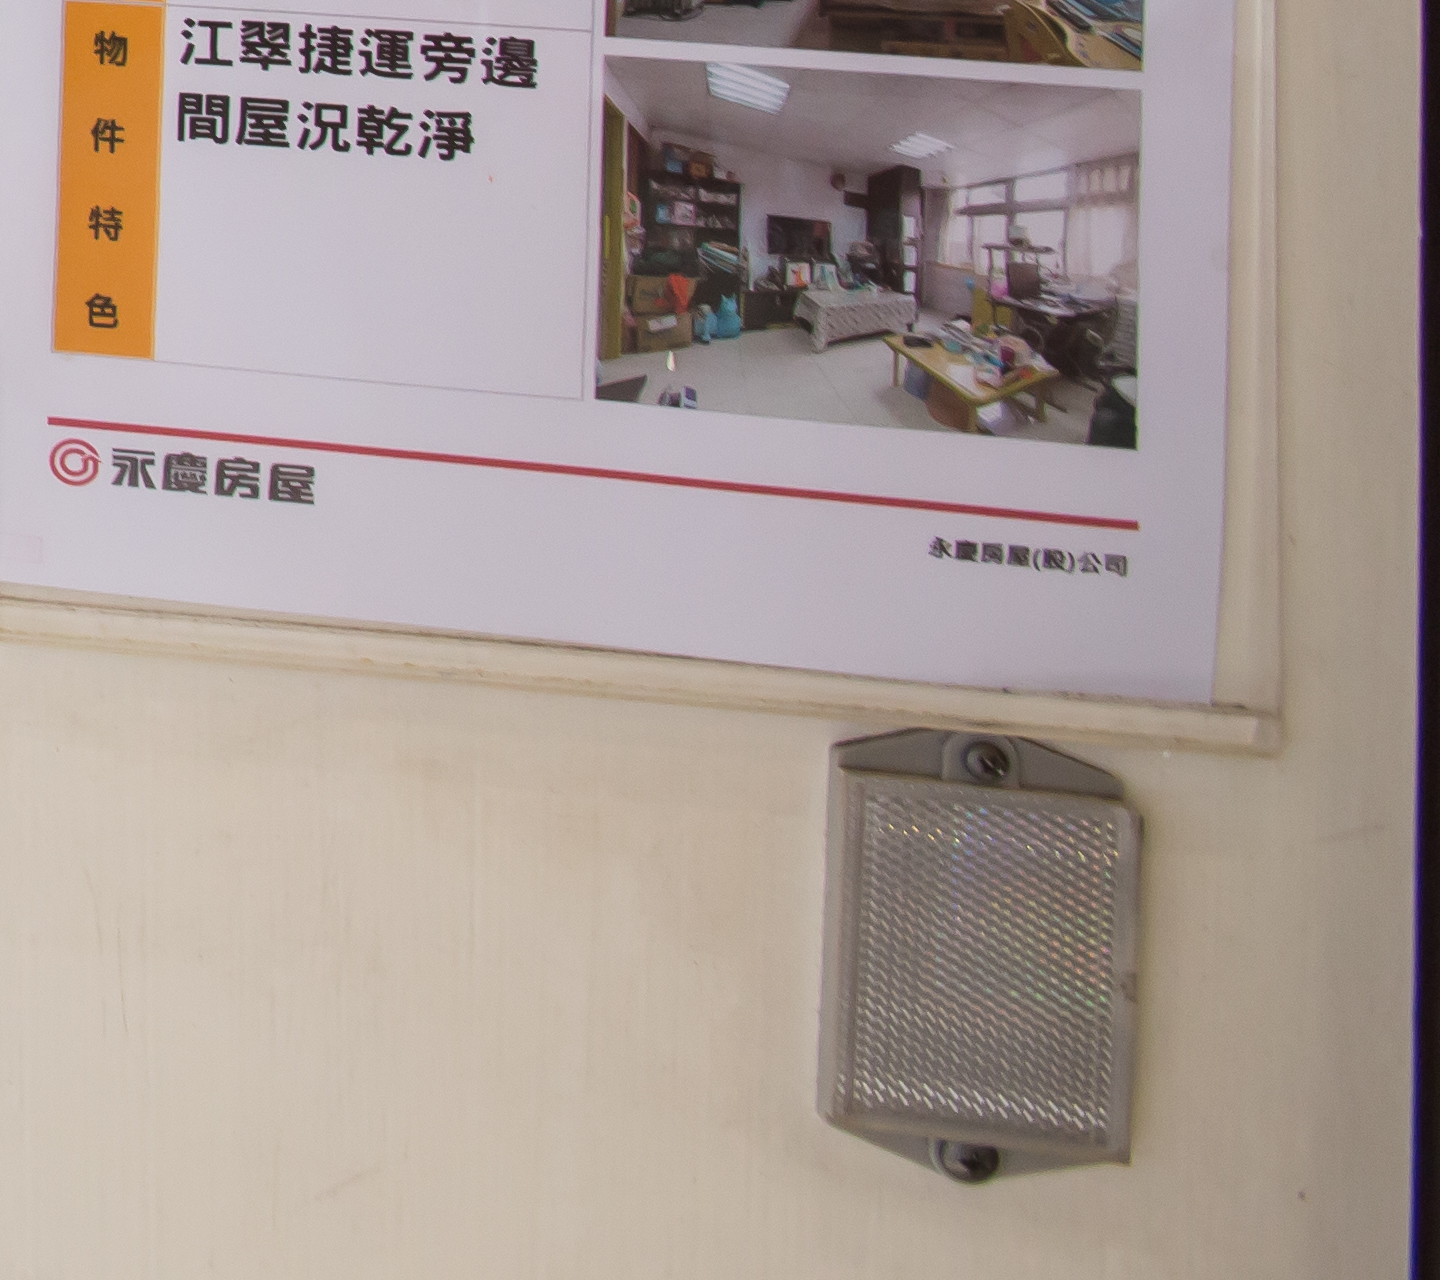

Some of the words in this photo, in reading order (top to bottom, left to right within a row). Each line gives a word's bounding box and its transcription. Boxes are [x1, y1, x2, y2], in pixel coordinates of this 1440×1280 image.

[180, 17, 538, 89] 江翠捷運旁邊
[177, 92, 475, 162] 間屋況乾淨
[111, 446, 315, 505] 永慶房屋
